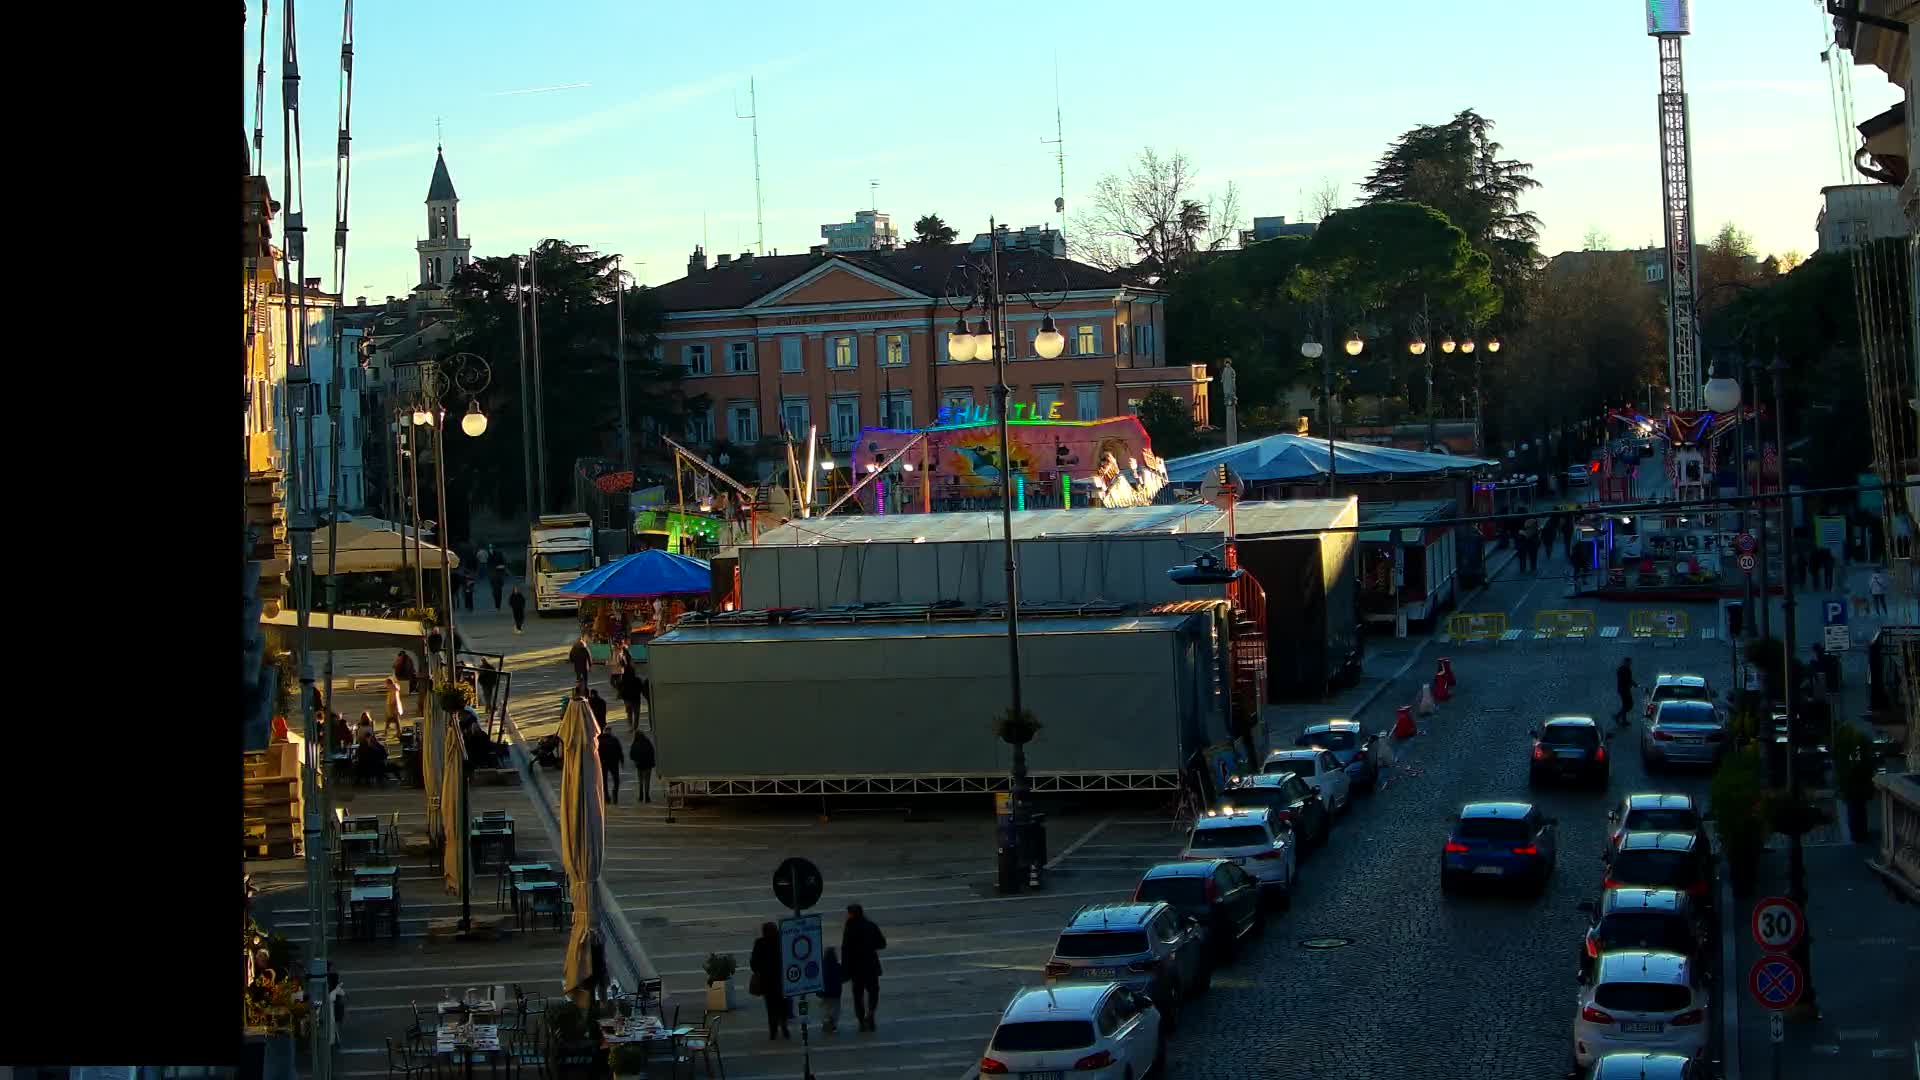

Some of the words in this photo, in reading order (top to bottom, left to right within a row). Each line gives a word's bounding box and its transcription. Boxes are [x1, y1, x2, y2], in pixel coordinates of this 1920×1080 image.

[938, 401, 1065, 424] SHUTLE
[1742, 558, 1753, 568] 20
[1826, 602, 1842, 622] P
[1762, 911, 1792, 938] 30
